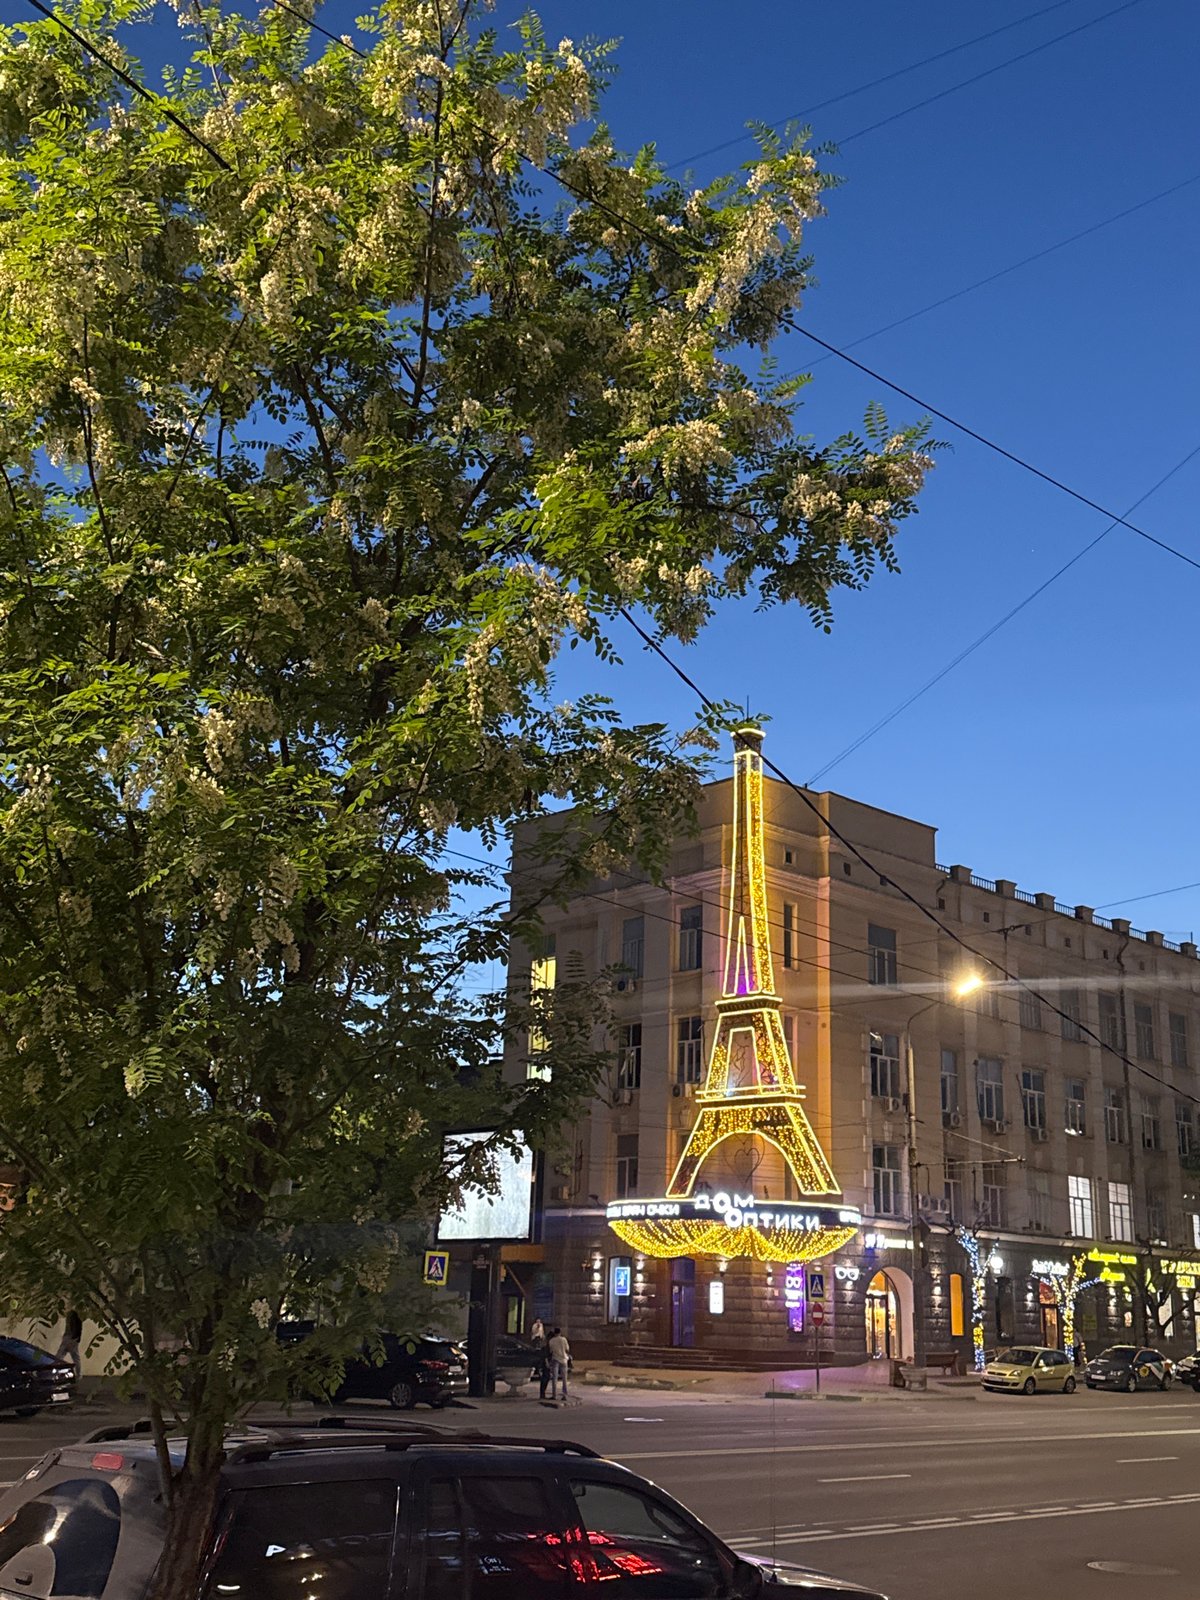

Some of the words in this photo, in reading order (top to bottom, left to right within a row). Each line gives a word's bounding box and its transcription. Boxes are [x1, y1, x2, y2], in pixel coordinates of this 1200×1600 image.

[647, 1204, 680, 1216] ОЧКИ
[694, 1192, 754, 1213] ДОМ
[724, 1207, 820, 1231] ОПТИКИ
